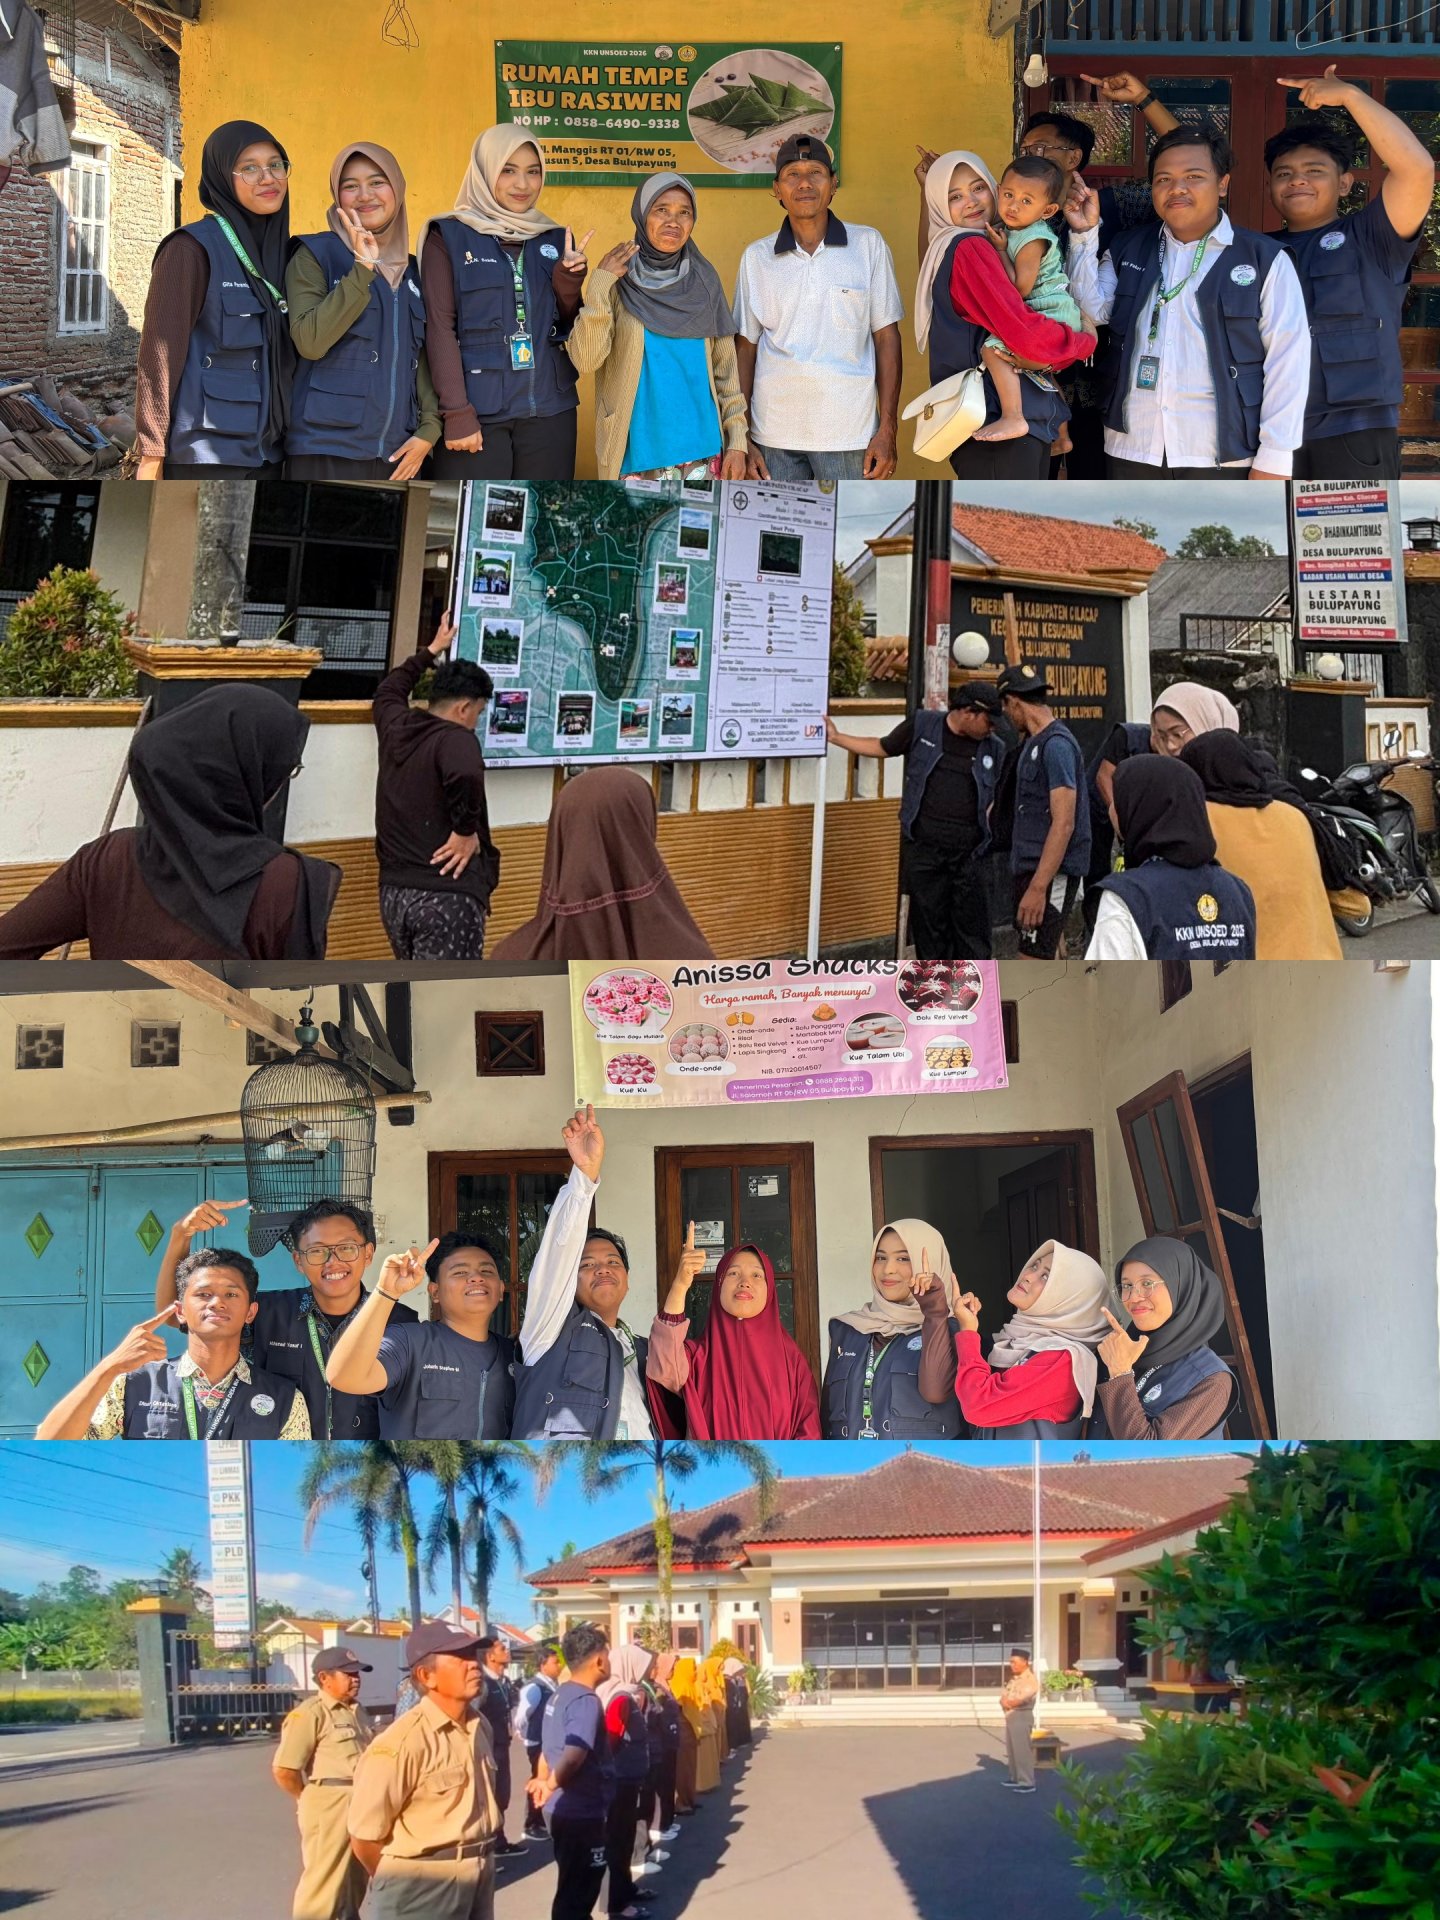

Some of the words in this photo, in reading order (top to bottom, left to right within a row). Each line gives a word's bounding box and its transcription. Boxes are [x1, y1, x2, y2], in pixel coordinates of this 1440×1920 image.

[502, 63, 599, 85] RUMAH
[604, 66, 688, 86] TEMPE
[508, 89, 556, 108] IBU
[561, 92, 682, 111] RASIWEN
[513, 115, 531, 126] NO
[534, 116, 551, 126] HP
[564, 117, 680, 129] 0858-6490-9338
[552, 146, 598, 156] Manggis
[600, 146, 614, 155] RT
[616, 147, 655, 157] 01/RW
[658, 149, 676, 158] 05,
[545, 157, 570, 166] usun
[572, 157, 583, 166] 5,
[585, 157, 610, 166] Desa
[613, 158, 677, 169] Bulupayung
[1300, 484, 1321, 493] DESA
[1324, 480, 1379, 491] BULUPAYUNG
[1324, 524, 1382, 538] BHABINKAMTIBMAS
[1303, 548, 1324, 557] DESA
[1326, 546, 1383, 556] BULUPAYUNG
[1367, 572, 1385, 580] DESA
[1308, 590, 1381, 599] LESTARI
[1024, 601, 1068, 620] KABUPATEN
[1069, 606, 1099, 622] CILACAP
[1309, 600, 1381, 611] BULUPAYUNG
[1305, 615, 1327, 624] DESA
[1329, 615, 1387, 625] BULUPAYUNG
[1042, 622, 1084, 640] KESUGIHAN
[1025, 641, 1071, 659] BULUPAYUNG
[1045, 664, 1107, 696] BULUPAYUNG
[1175, 926, 1195, 942] KKN
[1195, 924, 1228, 939] UNSOED
[1202, 939, 1239, 947] BULUPAYUNG
[672, 961, 771, 987] Anissa
[787, 960, 899, 977] Snacks
[703, 994, 739, 1008] Harga
[741, 991, 777, 1003] ramah,
[781, 987, 822, 1003] Banyak
[824, 985, 871, 1002] menunya!
[810, 1022, 845, 1030] Panggang
[810, 1037, 835, 1045] Lumpur
[738, 1049, 756, 1057] Lapis
[756, 1048, 787, 1056] Singkong
[796, 1045, 825, 1053] Kentang
[943, 1069, 968, 1078] Lumpur
[209, 1409, 226, 1430] UNSOED
[221, 1397, 232, 1410] 2026
[227, 1386, 238, 1399] DESA
[222, 1492, 240, 1503] PKK
[225, 1547, 243, 1557] PLD
